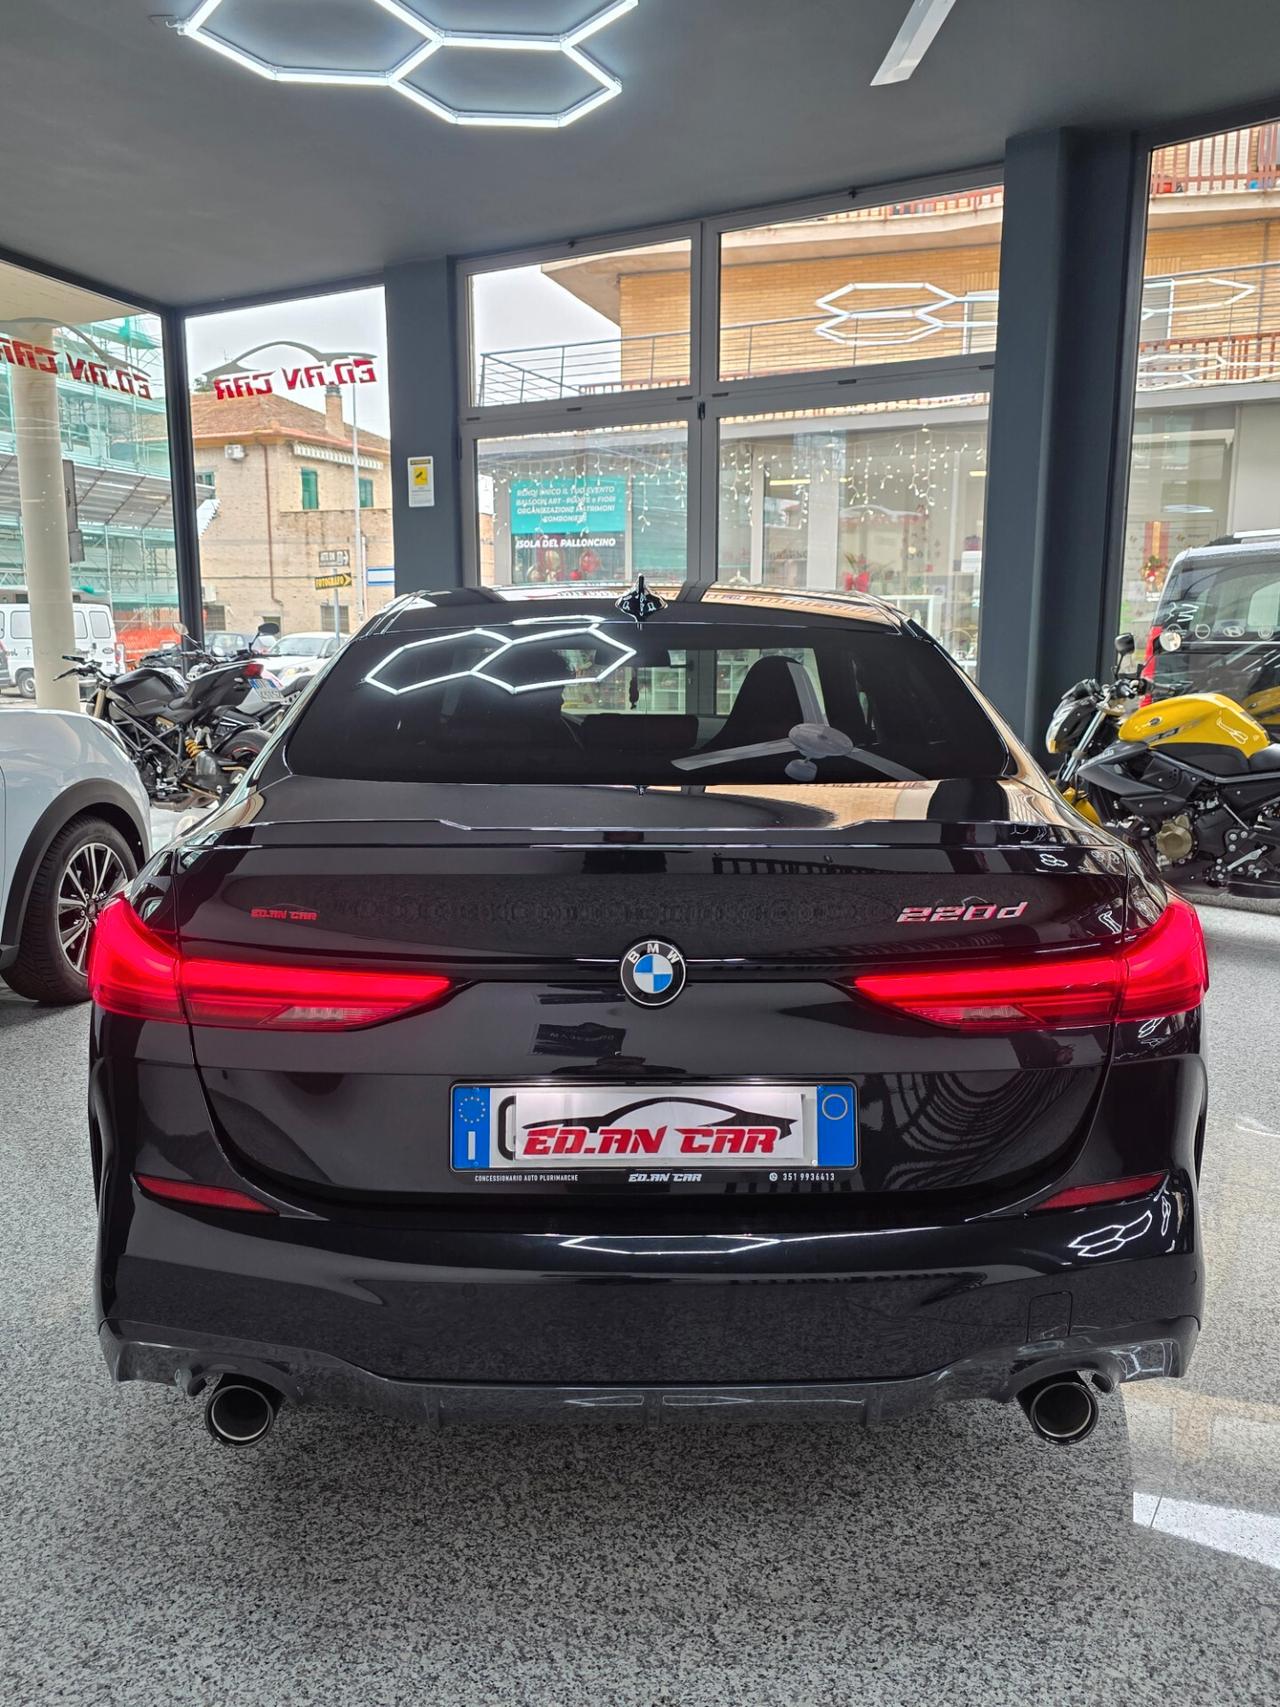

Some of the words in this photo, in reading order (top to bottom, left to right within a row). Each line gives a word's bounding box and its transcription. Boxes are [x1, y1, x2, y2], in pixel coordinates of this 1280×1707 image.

[515, 539, 540, 549] ISOLA
[541, 539, 559, 548] DEL
[560, 538, 616, 548] PALLONCINO
[289, 911, 317, 921] CAR
[896, 901, 1029, 922] 220d
[627, 943, 680, 964] BMW
[522, 1126, 669, 1156] ED.AN
[674, 1127, 779, 1154] CAR
[474, 1174, 522, 1182] CONCESSIONARIO
[628, 1172, 671, 1182] ED.AN
[672, 1172, 702, 1182] CAR
[782, 1172, 797, 1182] 351
